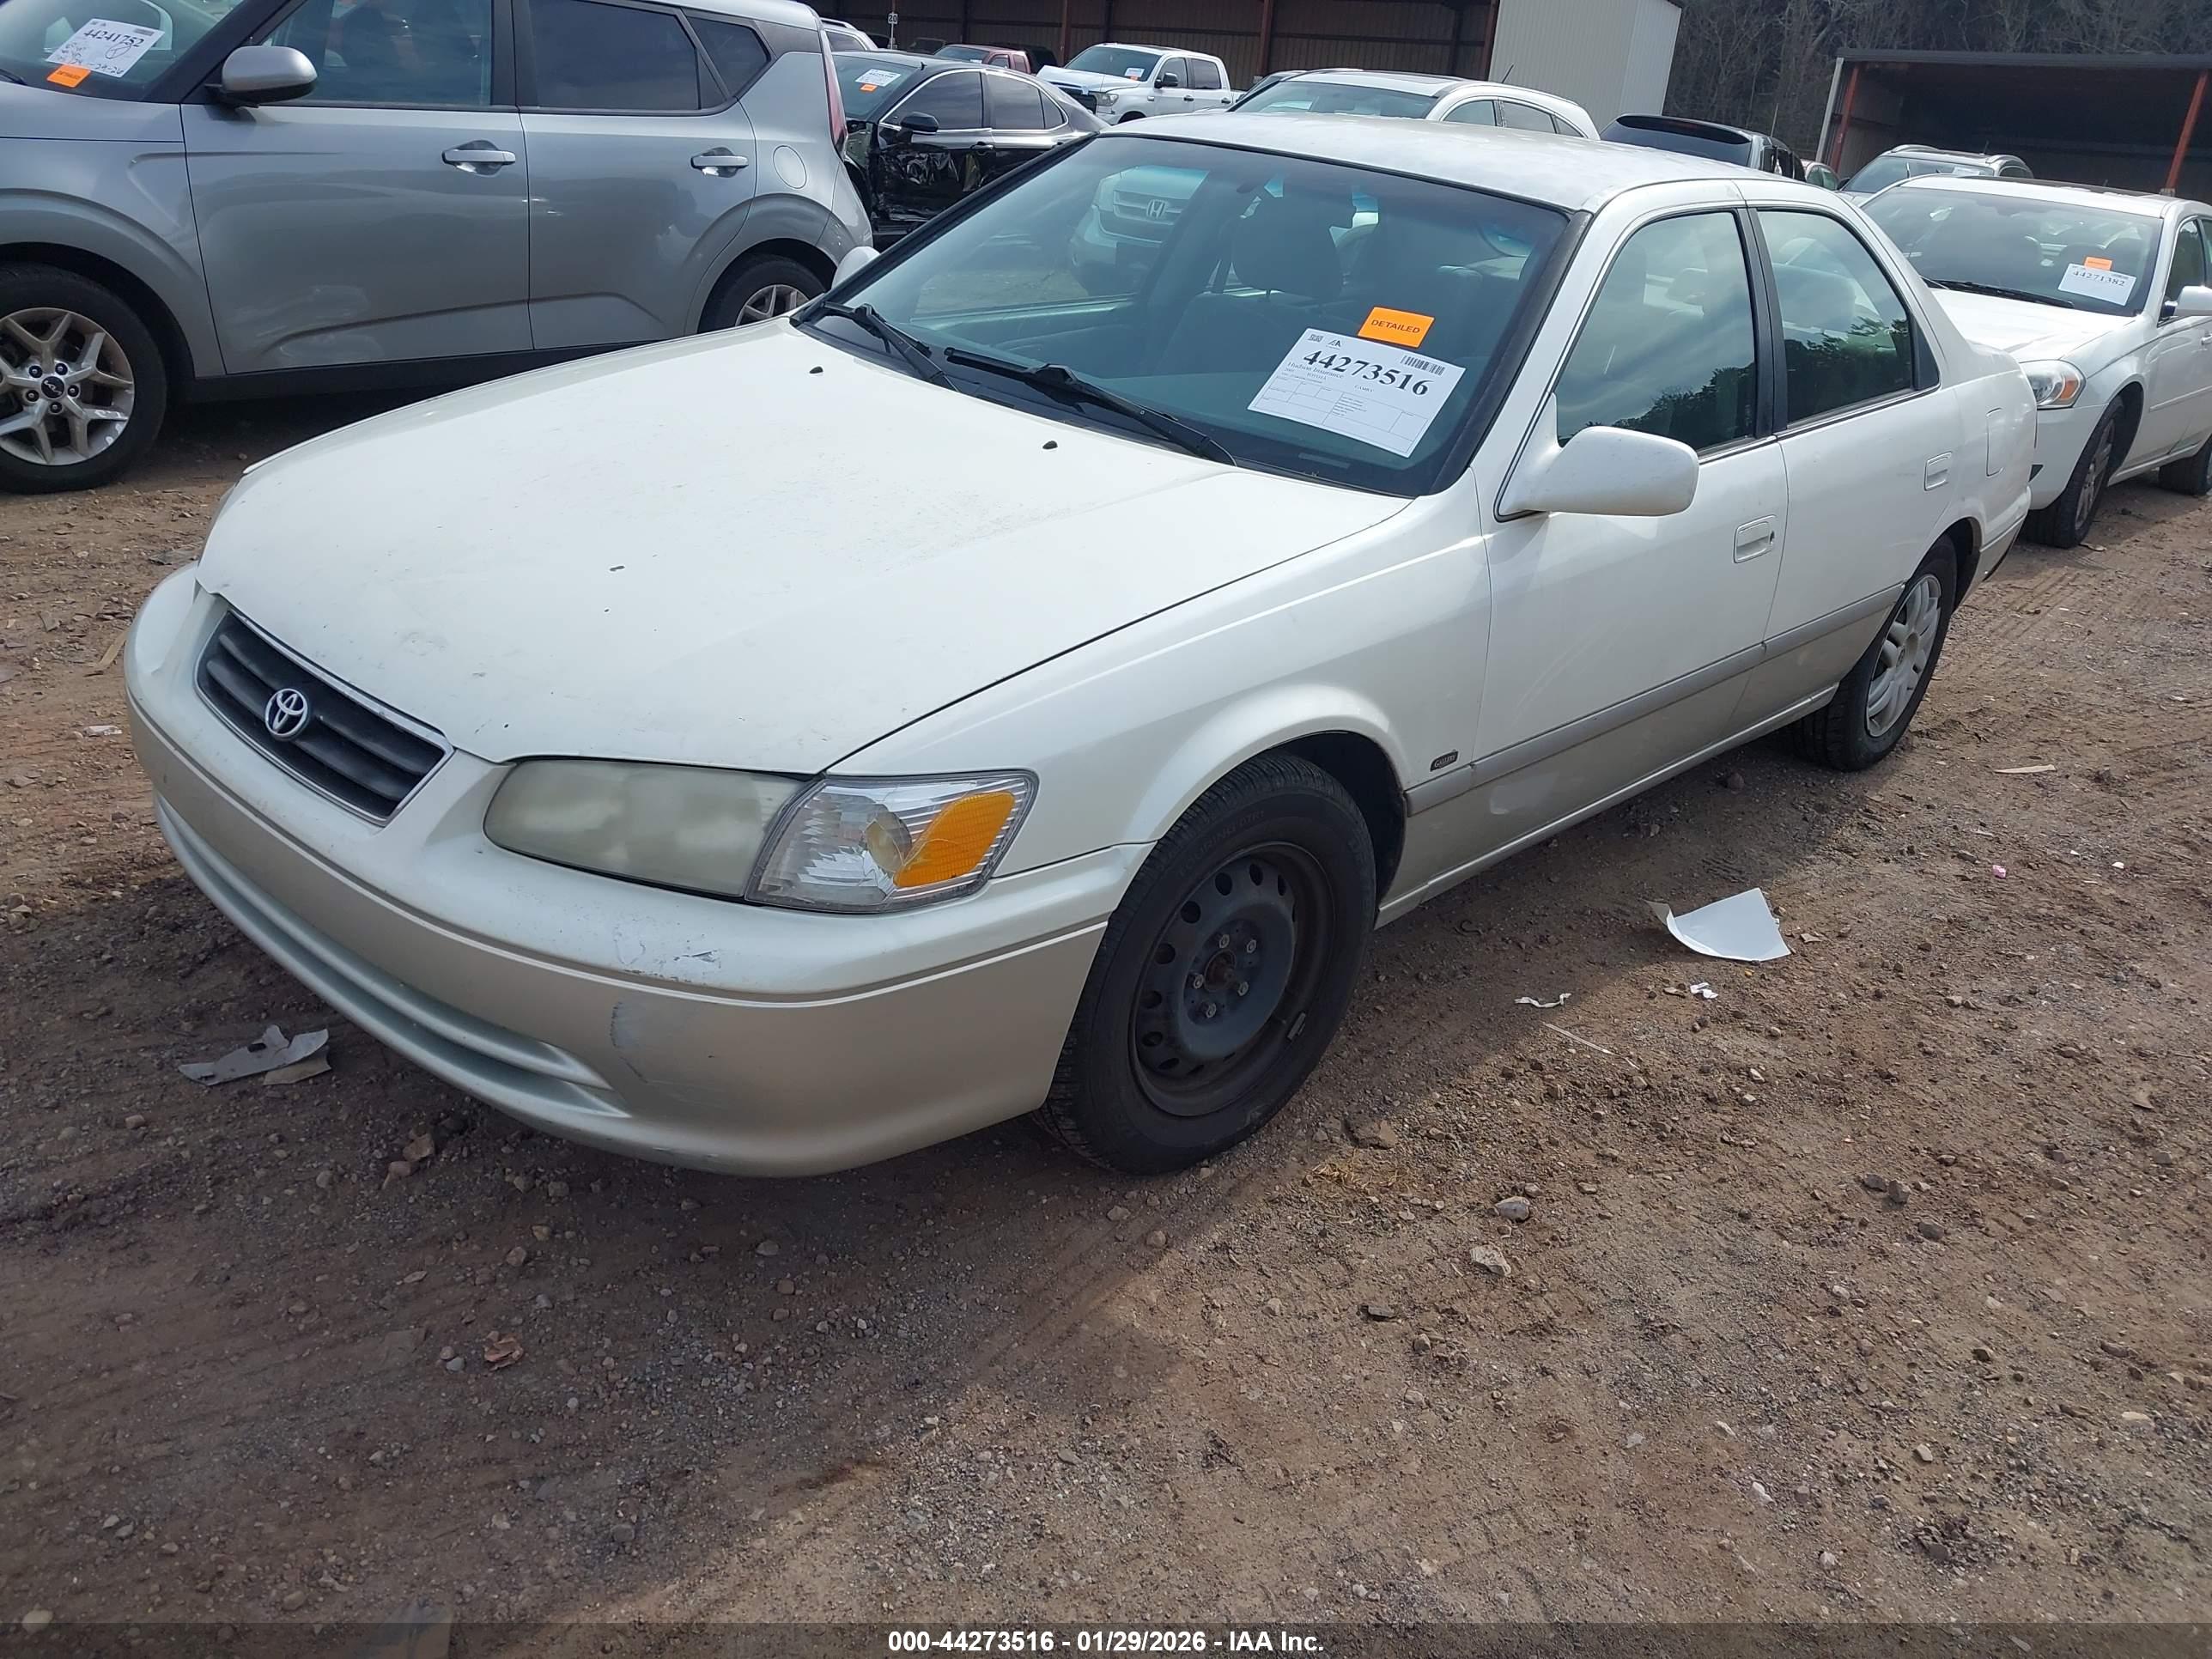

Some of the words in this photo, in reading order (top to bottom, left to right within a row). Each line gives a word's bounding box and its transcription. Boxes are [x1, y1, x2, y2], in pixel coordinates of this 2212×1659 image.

[83, 28, 145, 48] 44241752
[2073, 270, 2125, 286] 44271382
[1371, 319, 1421, 334] DETAILED
[1304, 350, 1434, 396] 44273516
[1313, 367, 1345, 379] Insurance
